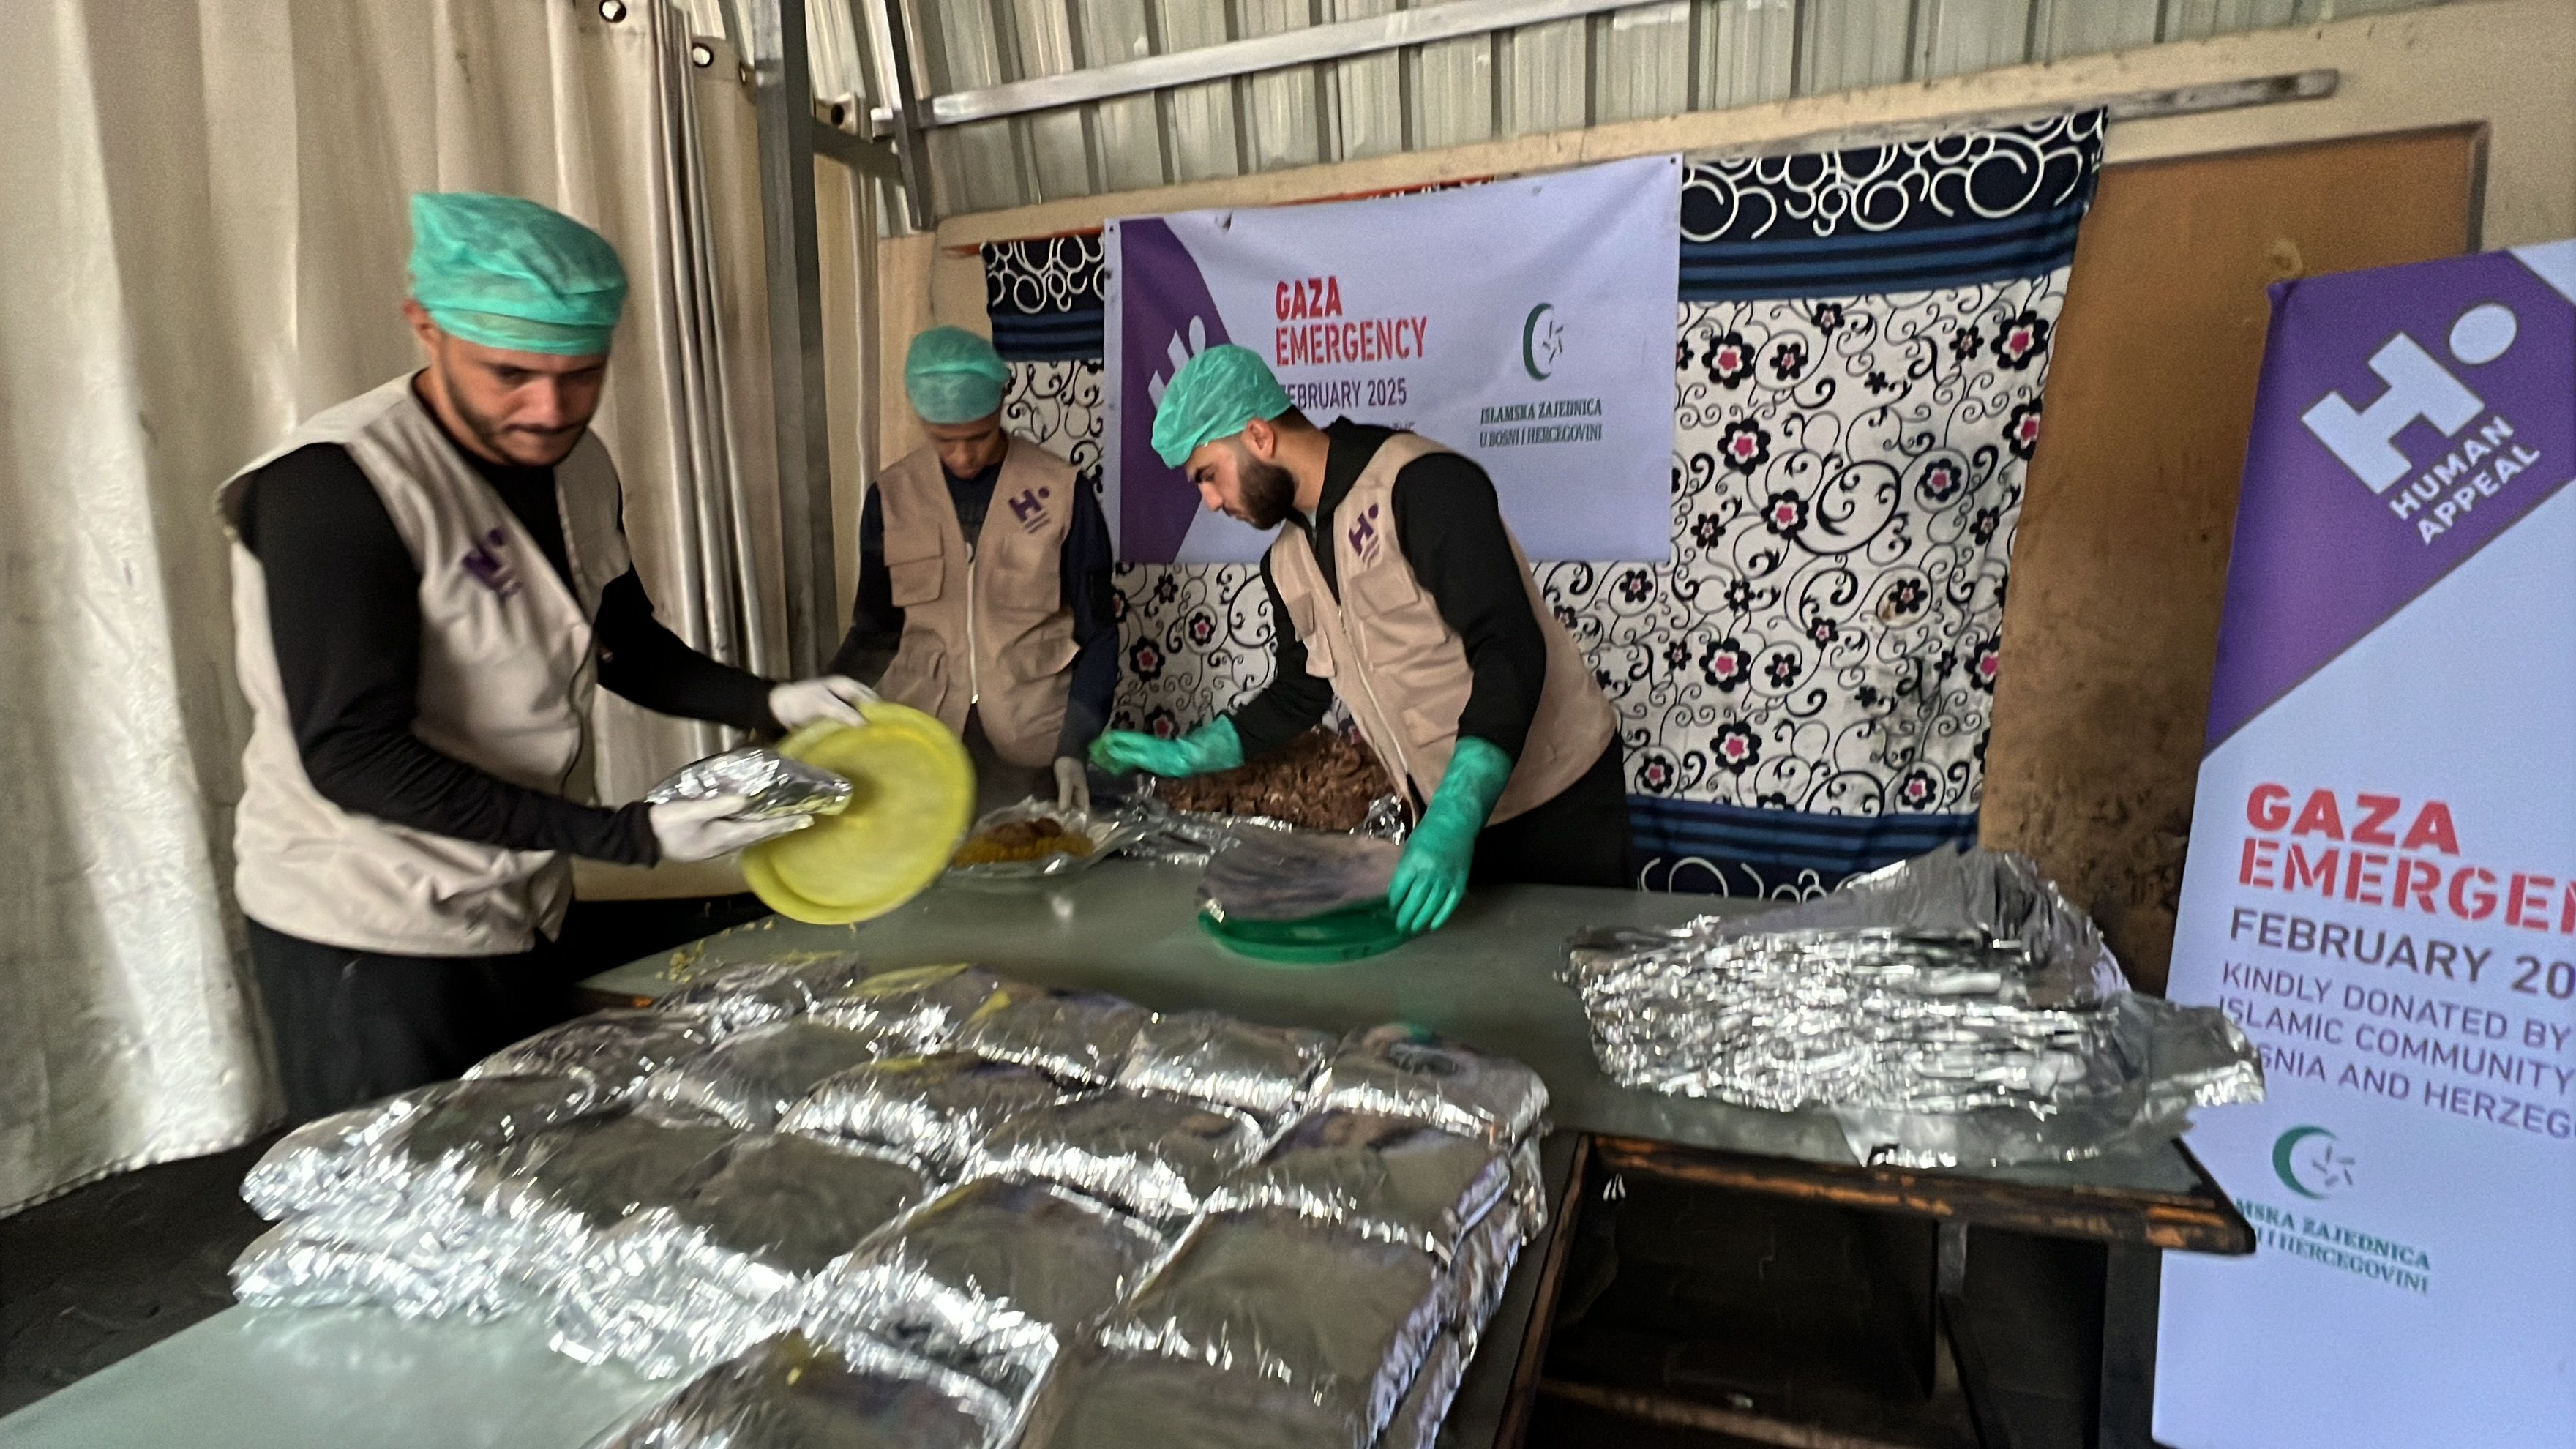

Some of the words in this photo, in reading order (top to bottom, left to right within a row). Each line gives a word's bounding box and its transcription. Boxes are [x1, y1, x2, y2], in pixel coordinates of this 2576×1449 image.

[1276, 275, 1343, 322] GAZA
[1276, 315, 1428, 367] EMERGENCY
[1279, 380, 1361, 410] EBRUARY
[1368, 377, 1407, 407] 2025
[1538, 397, 1602, 419] ZAJEDNICA
[2389, 415, 2515, 521] HUMAN
[2417, 445, 2541, 546] APPEAL
[2246, 782, 2461, 857] GAZA
[2230, 907, 2493, 984] FEBRUARY
[2223, 960, 2333, 1004] KINDLY
[2343, 984, 2508, 1040] DONATED
[2524, 1016, 2572, 1052] BY
[2219, 995, 2344, 1044] ISLAMIC
[2355, 1022, 2576, 1096] COMMUNITY
[2256, 1042, 2326, 1082] SNIA
[2338, 1062, 2411, 1101] AND
[2424, 1079, 2576, 1139] HERZEG
[2236, 1199, 2294, 1231] MSKA
[2302, 1216, 2430, 1270] ZAJEDNICA
[2279, 1232, 2429, 1295] HERCEGOVINI
